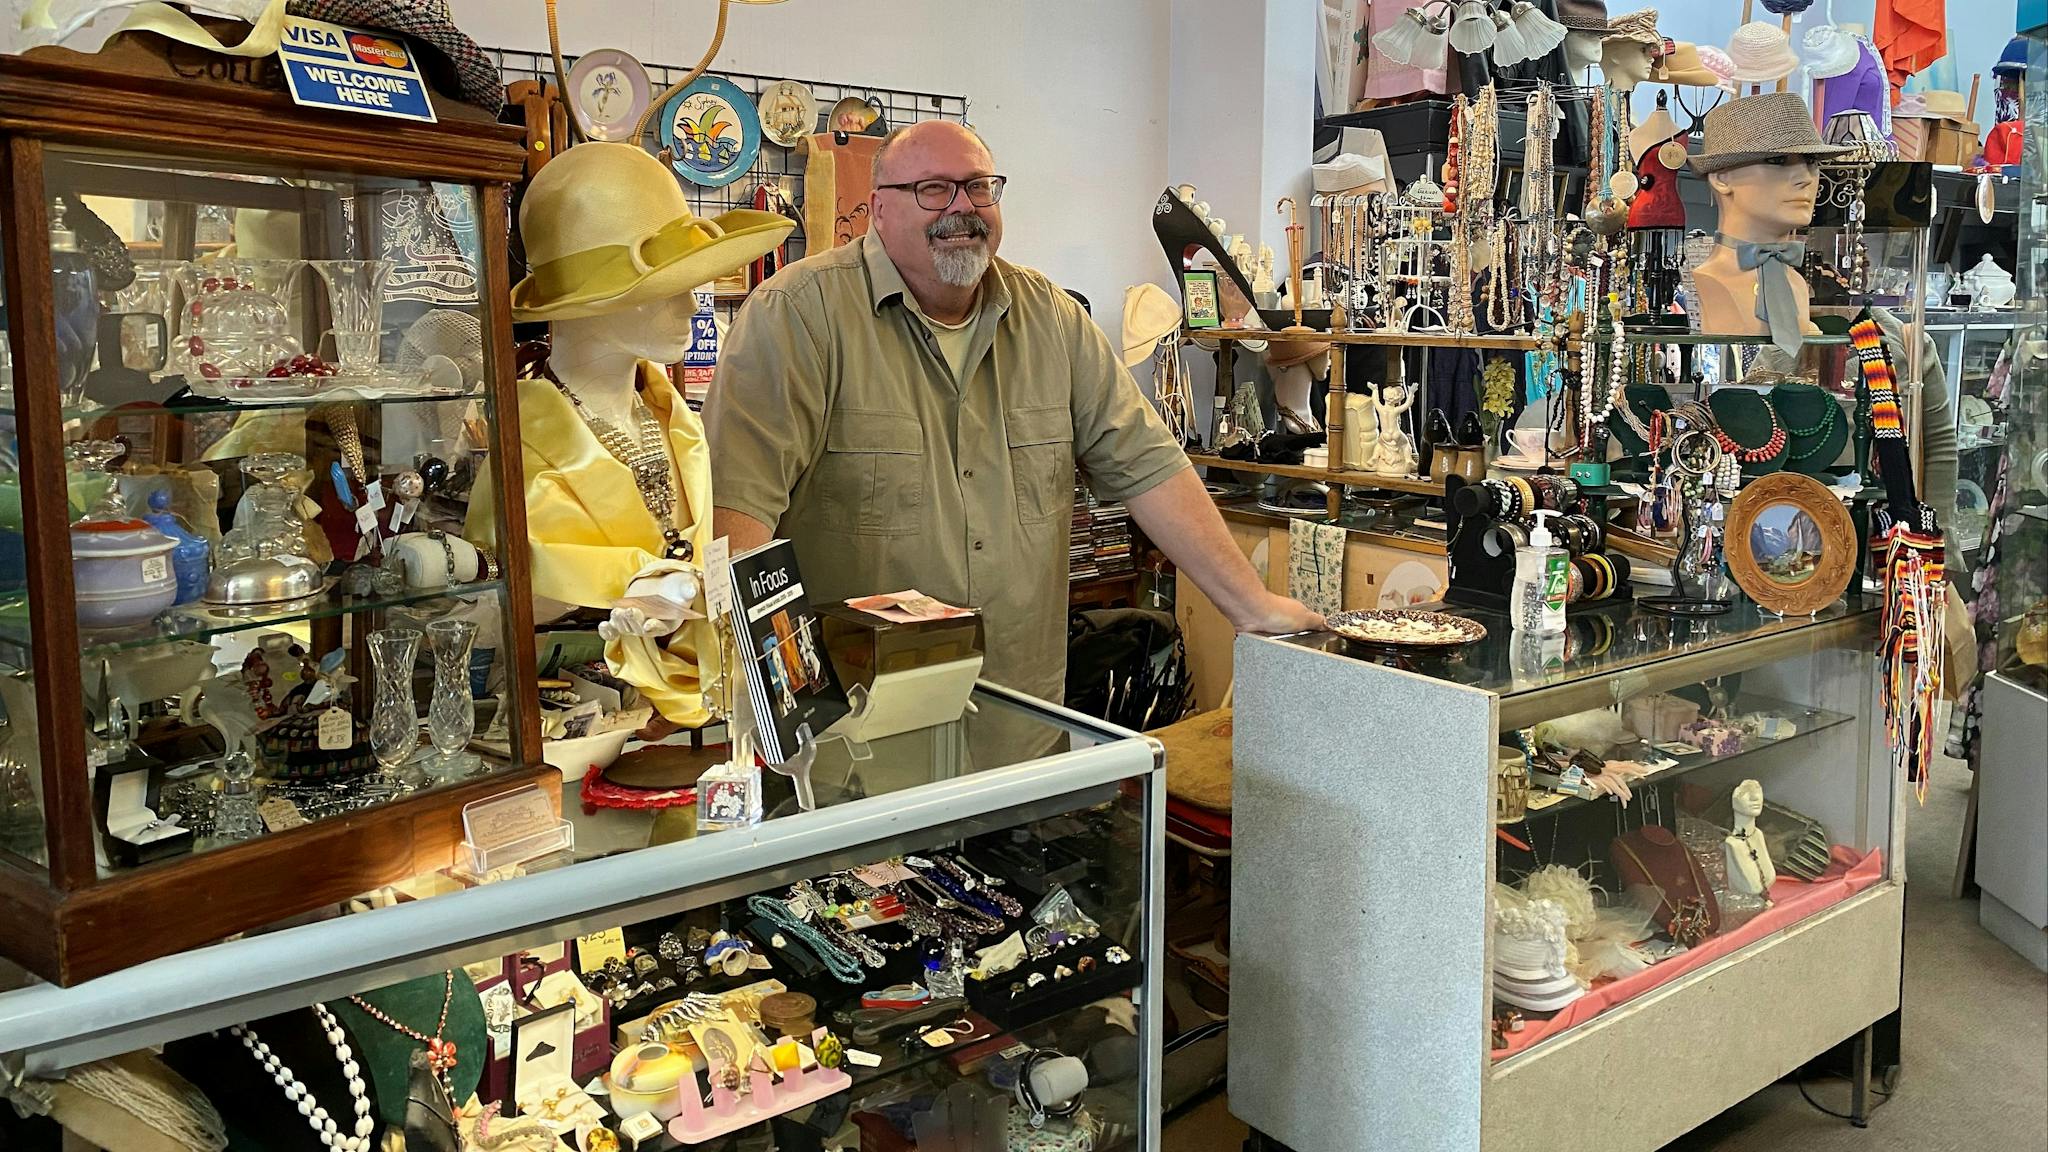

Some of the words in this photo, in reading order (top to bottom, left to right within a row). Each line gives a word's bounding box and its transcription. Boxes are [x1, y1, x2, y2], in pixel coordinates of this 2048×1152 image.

[283, 26, 341, 48] VISA
[352, 42, 406, 59] MasterCard
[304, 65, 410, 95] WELCOME
[336, 86, 393, 108] HERE
[697, 338, 717, 351] OFF
[749, 577, 762, 599] In
[759, 567, 789, 594] Focus
